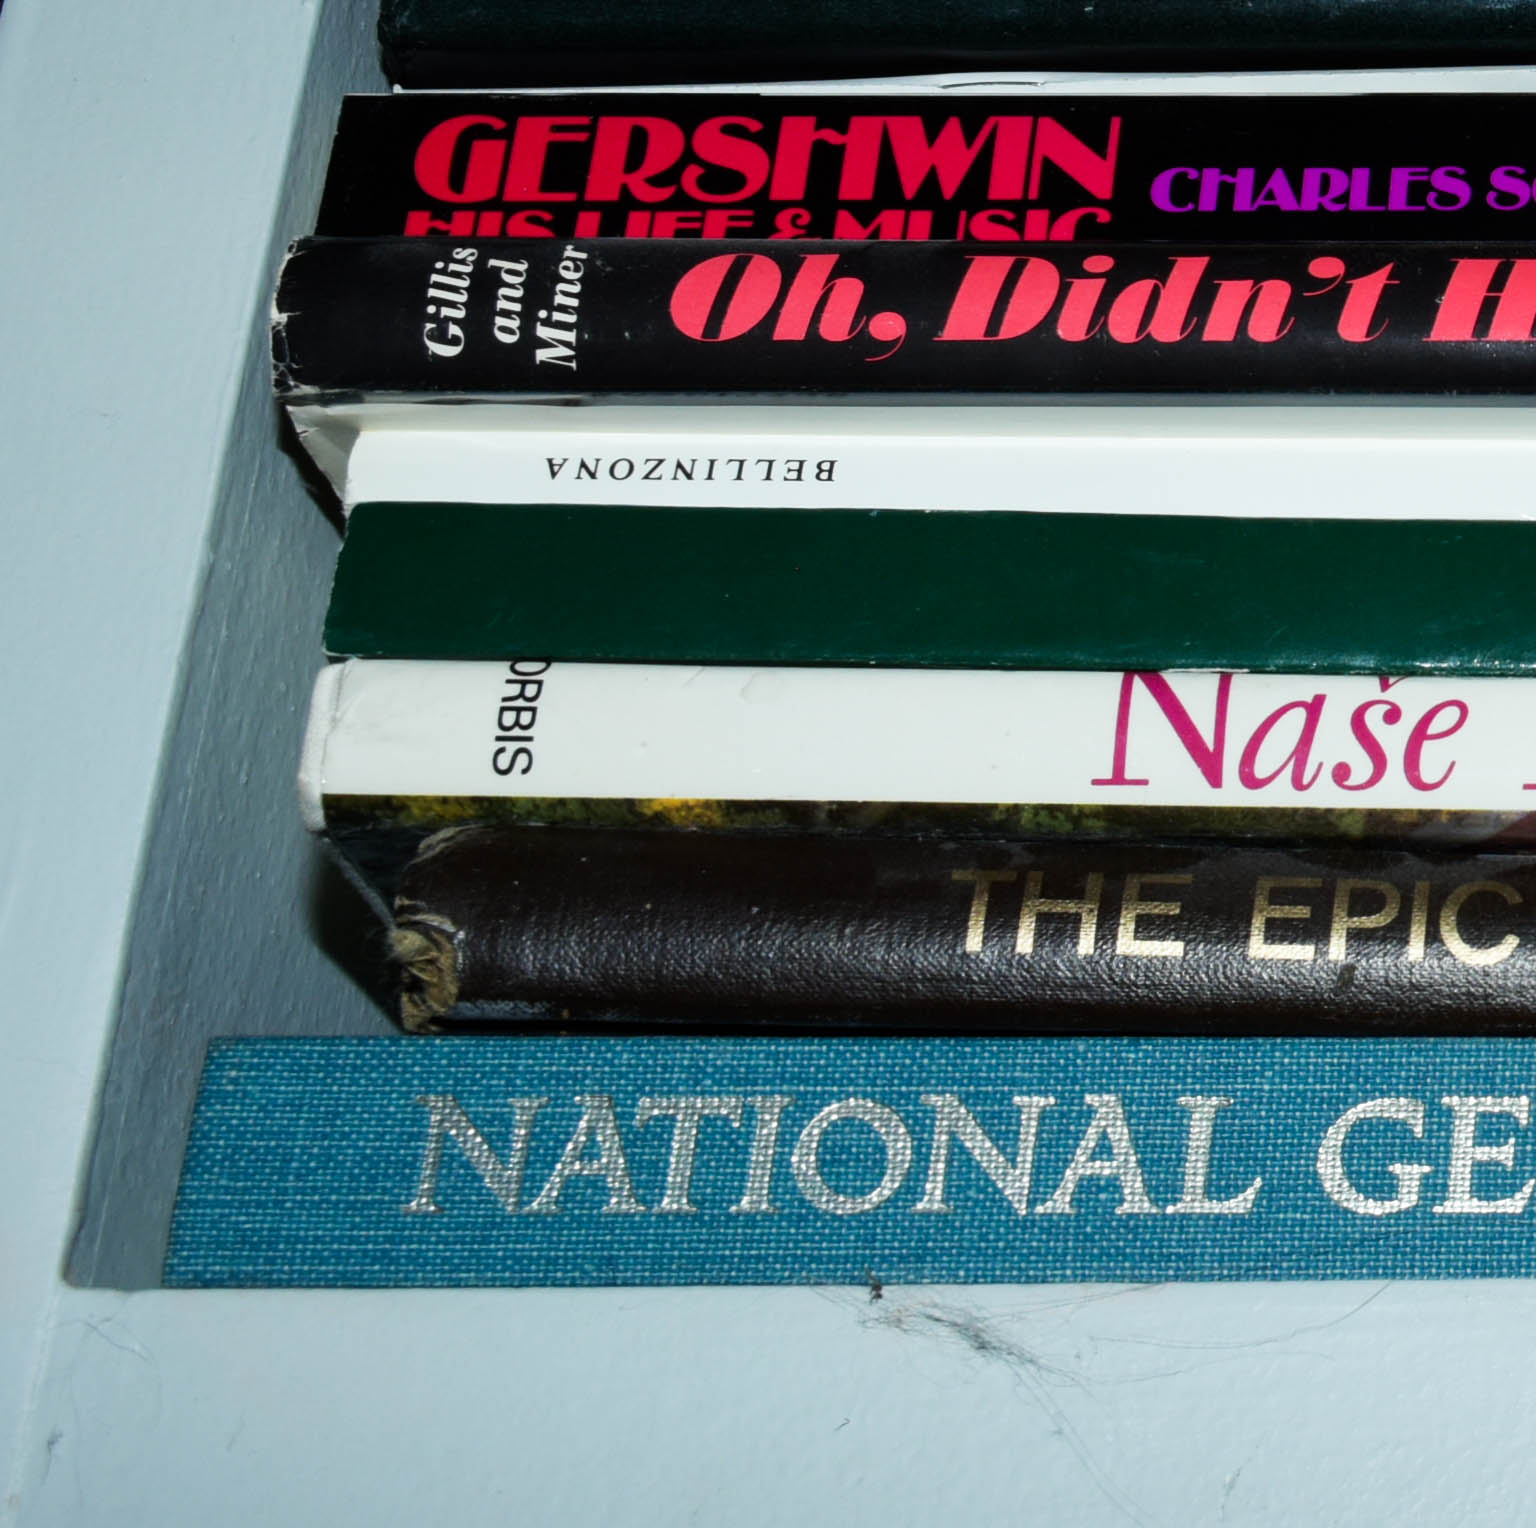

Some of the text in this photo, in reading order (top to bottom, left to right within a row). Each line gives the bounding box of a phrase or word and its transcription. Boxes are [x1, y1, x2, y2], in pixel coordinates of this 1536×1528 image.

[414, 114, 1122, 205] GERSHWIN
[1150, 165, 1472, 213] CHARLES
[423, 247, 479, 358] Gillis
[488, 259, 528, 344] and
[535, 244, 588, 371] Miner
[669, 252, 908, 362] Oh,
[932, 255, 1401, 343] Didn't
[546, 457, 838, 482] BELLINZONA
[493, 659, 552, 776] ORBIS
[1091, 672, 1468, 791] Naše
[951, 869, 1193, 957] THE
[1248, 876, 1524, 967] EPIC
[404, 1093, 1262, 1217] NATIONAL
